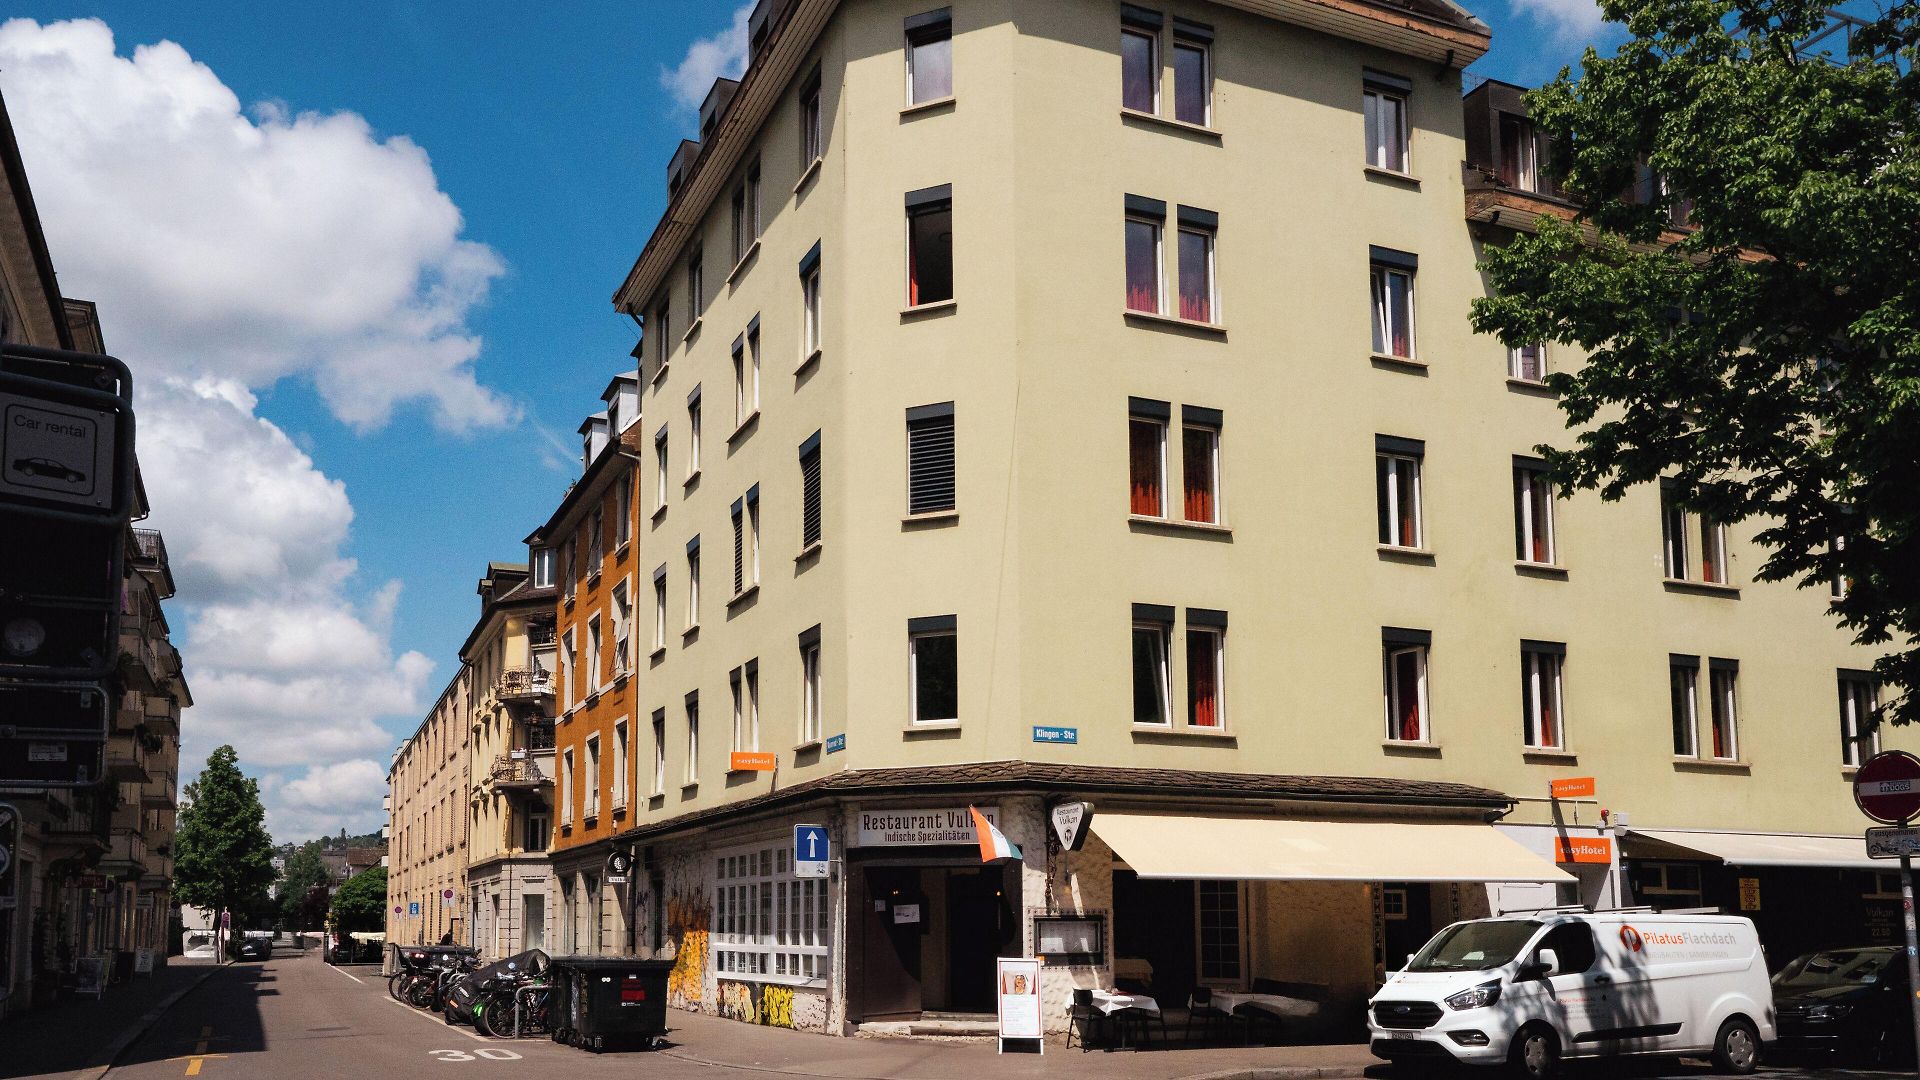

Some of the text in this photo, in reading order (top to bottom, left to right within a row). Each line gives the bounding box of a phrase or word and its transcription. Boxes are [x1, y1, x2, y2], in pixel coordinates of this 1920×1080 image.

[14, 414, 86, 438] Car rental
[736, 757, 770, 765] easyHotel
[1555, 784, 1585, 792] easyHotel
[863, 811, 994, 830] Restaurant Vulkn
[885, 830, 970, 843] Indische Spezialitäten
[1561, 845, 1606, 855] easyHotel
[428, 1048, 523, 1061] 30
